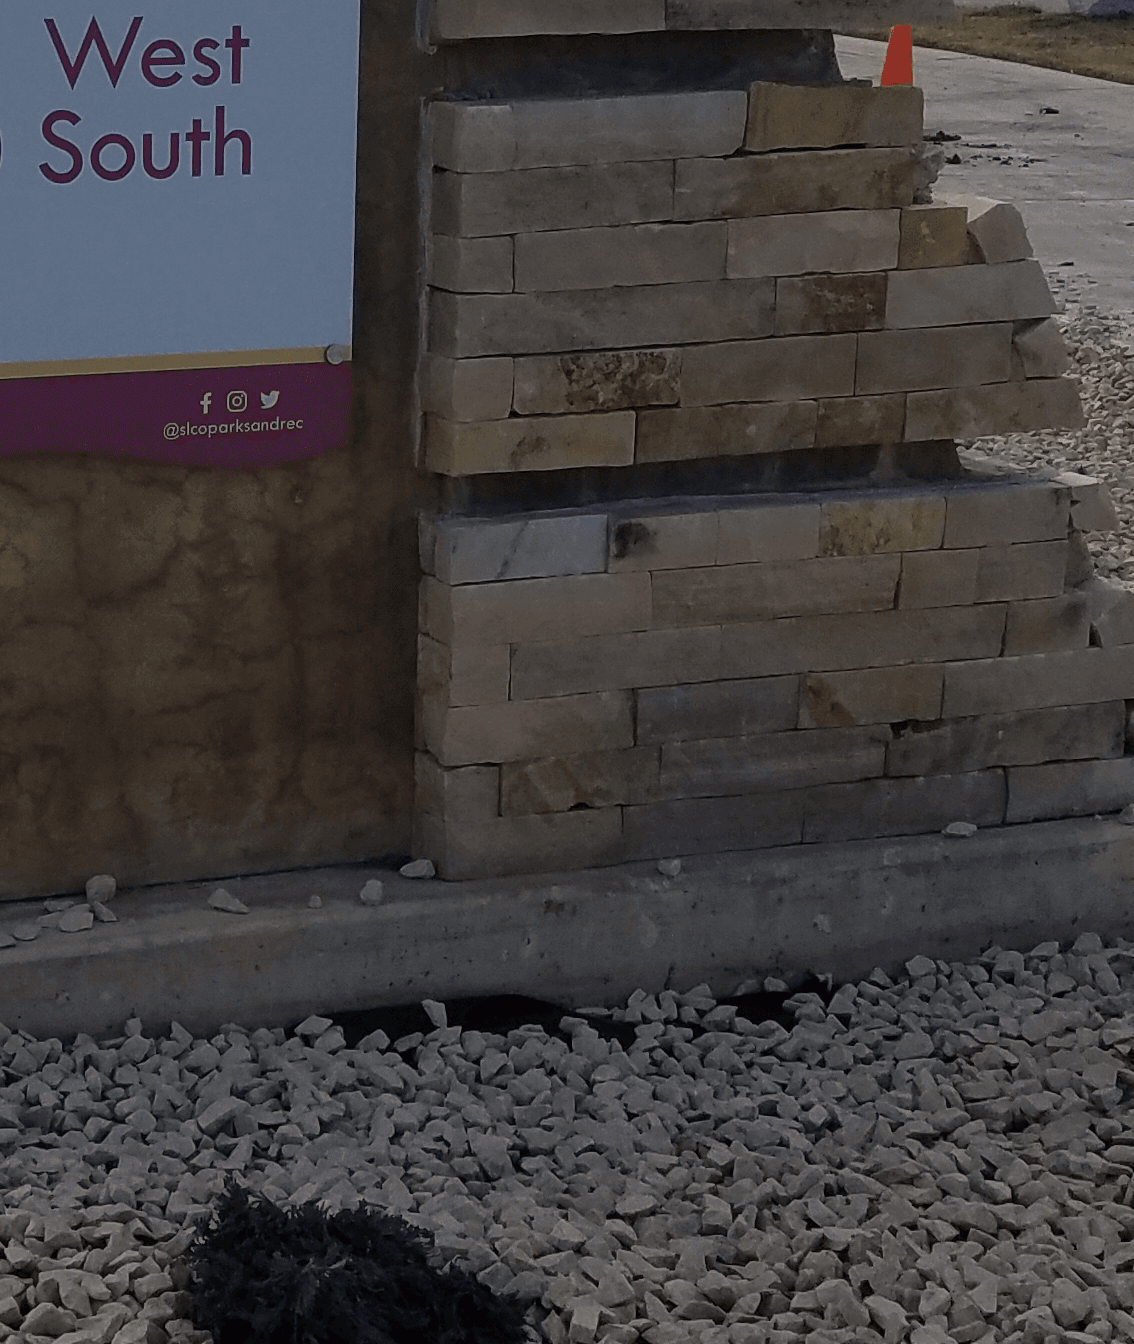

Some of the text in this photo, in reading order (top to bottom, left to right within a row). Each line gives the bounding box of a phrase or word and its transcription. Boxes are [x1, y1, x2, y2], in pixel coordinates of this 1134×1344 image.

[44, 16, 250, 90] West
[39, 106, 251, 183] South
[163, 416, 304, 440] @slcoparksandrec
